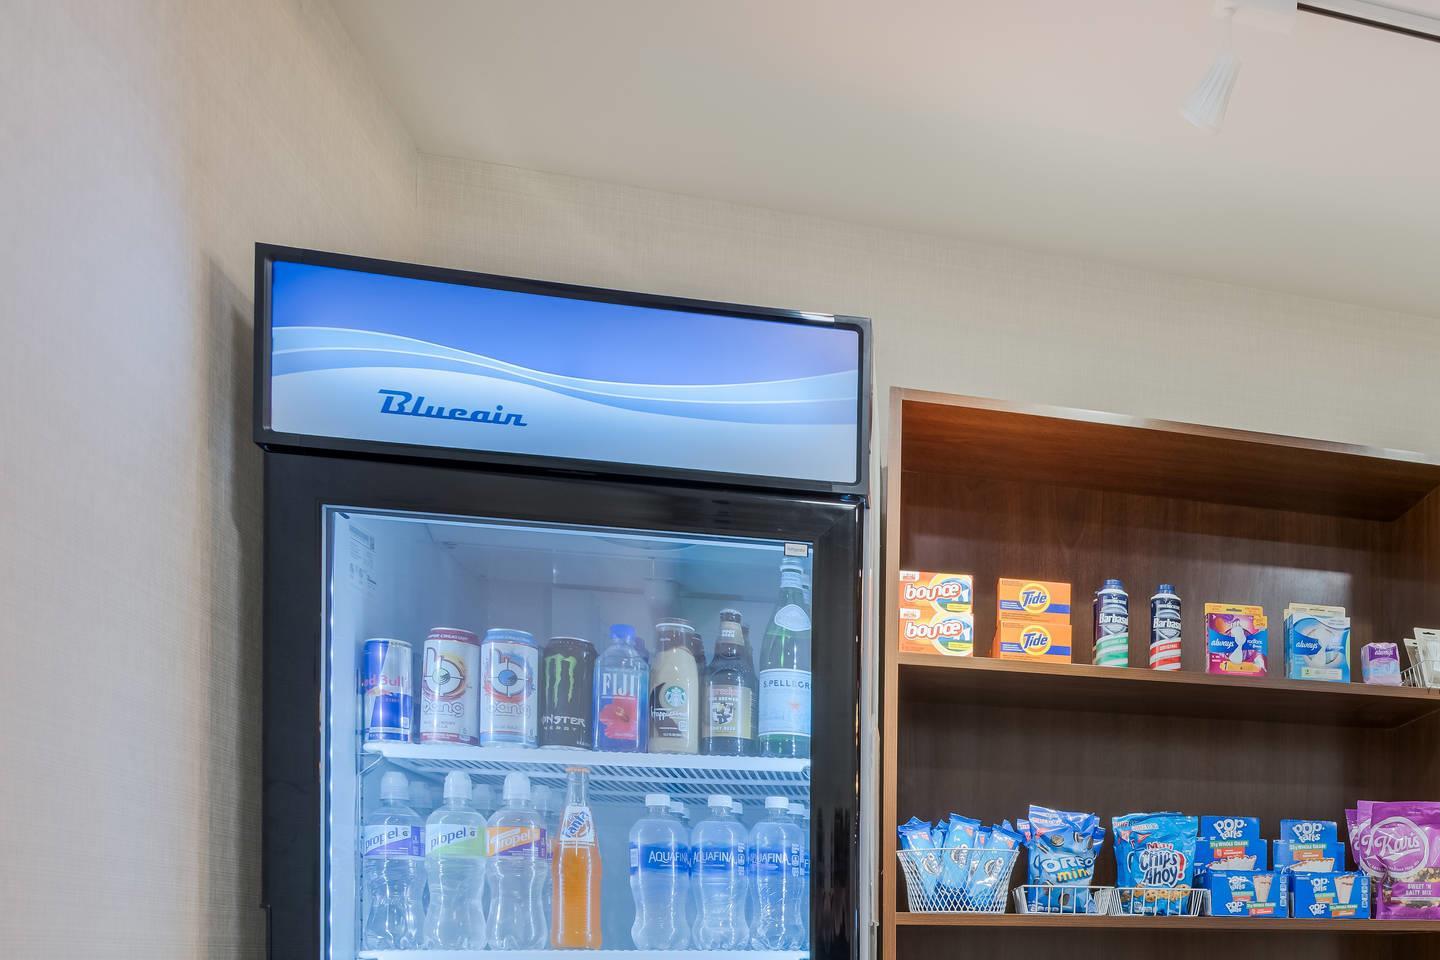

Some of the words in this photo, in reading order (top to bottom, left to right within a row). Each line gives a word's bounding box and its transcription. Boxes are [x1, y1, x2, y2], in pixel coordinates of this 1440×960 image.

[377, 389, 528, 427] Blueair
[904, 581, 961, 601] bounce
[1022, 590, 1047, 607] Tide
[904, 620, 963, 640] bounce
[1023, 632, 1048, 650] Tide
[1211, 639, 1235, 648] always
[1295, 640, 1318, 651] always
[365, 826, 399, 849] propel
[1041, 856, 1094, 873] OREO
